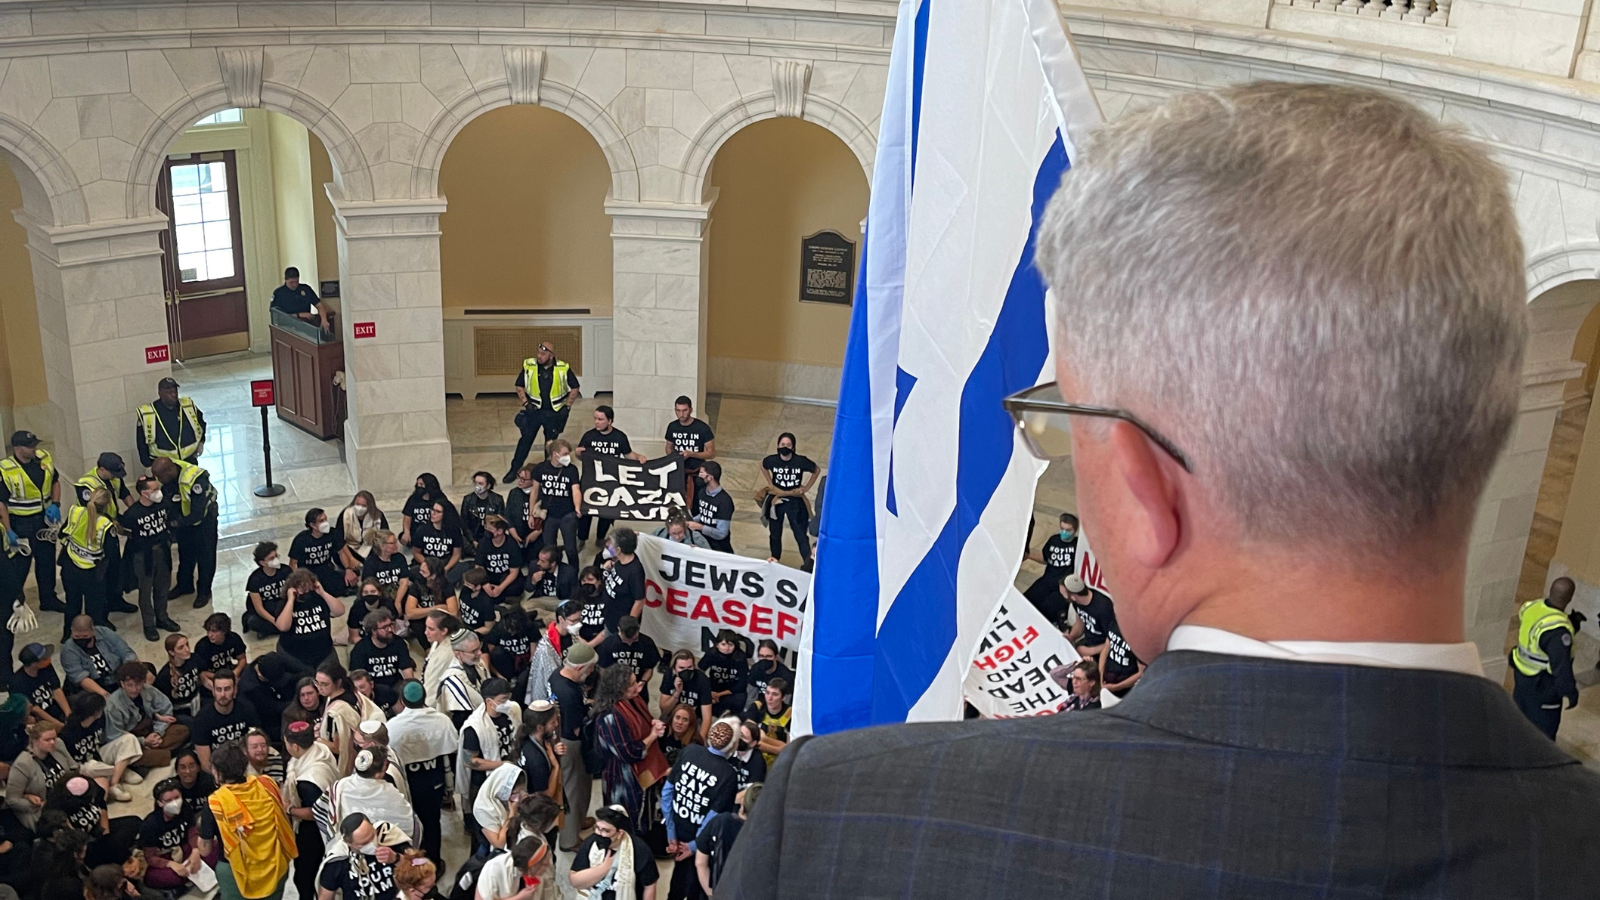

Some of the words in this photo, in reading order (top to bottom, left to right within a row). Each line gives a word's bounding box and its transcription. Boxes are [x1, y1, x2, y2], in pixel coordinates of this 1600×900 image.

[356, 325, 374, 335] EXIT
[147, 349, 167, 359] EXIT
[672, 432, 688, 440] NOT
[593, 459, 678, 489] LET
[545, 481, 566, 489] OUR
[542, 489, 569, 497] NAME
[583, 486, 686, 507] GAZA
[699, 507, 713, 517] OUR
[709, 504, 718, 512] IN
[137, 513, 155, 525] NOT
[157, 508, 167, 520] IN
[143, 517, 164, 530] OUR
[423, 535, 441, 544] NOT
[324, 542, 333, 550] IN
[426, 543, 448, 551] OUR
[309, 550, 330, 559] OUR
[1051, 553, 1071, 561] OUR
[392, 568, 401, 576] IN
[258, 583, 277, 593] NOT
[659, 554, 765, 598] JEWS
[775, 579, 808, 613] S
[292, 610, 310, 618] NOT
[312, 606, 323, 615] IN
[470, 606, 480, 618] IN
[581, 609, 602, 618] OUR
[645, 579, 804, 641] CEASEF
[297, 614, 321, 626] OUR
[581, 617, 605, 626] AME
[295, 620, 327, 634] NAME
[499, 639, 518, 647] NOT
[1108, 631, 1121, 644] NOT
[1121, 641, 1131, 651] IN
[972, 625, 1040, 671] FIGH
[368, 657, 385, 665] NOT
[387, 655, 398, 663] IN
[1109, 650, 1130, 666] AME
[987, 650, 1032, 683] AND
[178, 673, 190, 684] OT
[680, 695, 695, 706] UR
[688, 691, 699, 700] IN
[1008, 687, 1063, 714] THE
[211, 725, 234, 737] NOT
[235, 722, 246, 730] IN
[217, 731, 242, 743] OUR
[408, 759, 437, 772] OW
[681, 761, 718, 787] JEWS
[680, 773, 708, 795] SAY
[674, 782, 710, 807] CEASE
[676, 794, 701, 813] FIRE
[79, 805, 100, 826] OUR
[672, 800, 706, 825] NOW
[162, 833, 185, 847] OU
[349, 862, 377, 880] NT
[358, 866, 393, 888] OUR
[354, 881, 394, 897] NAM
